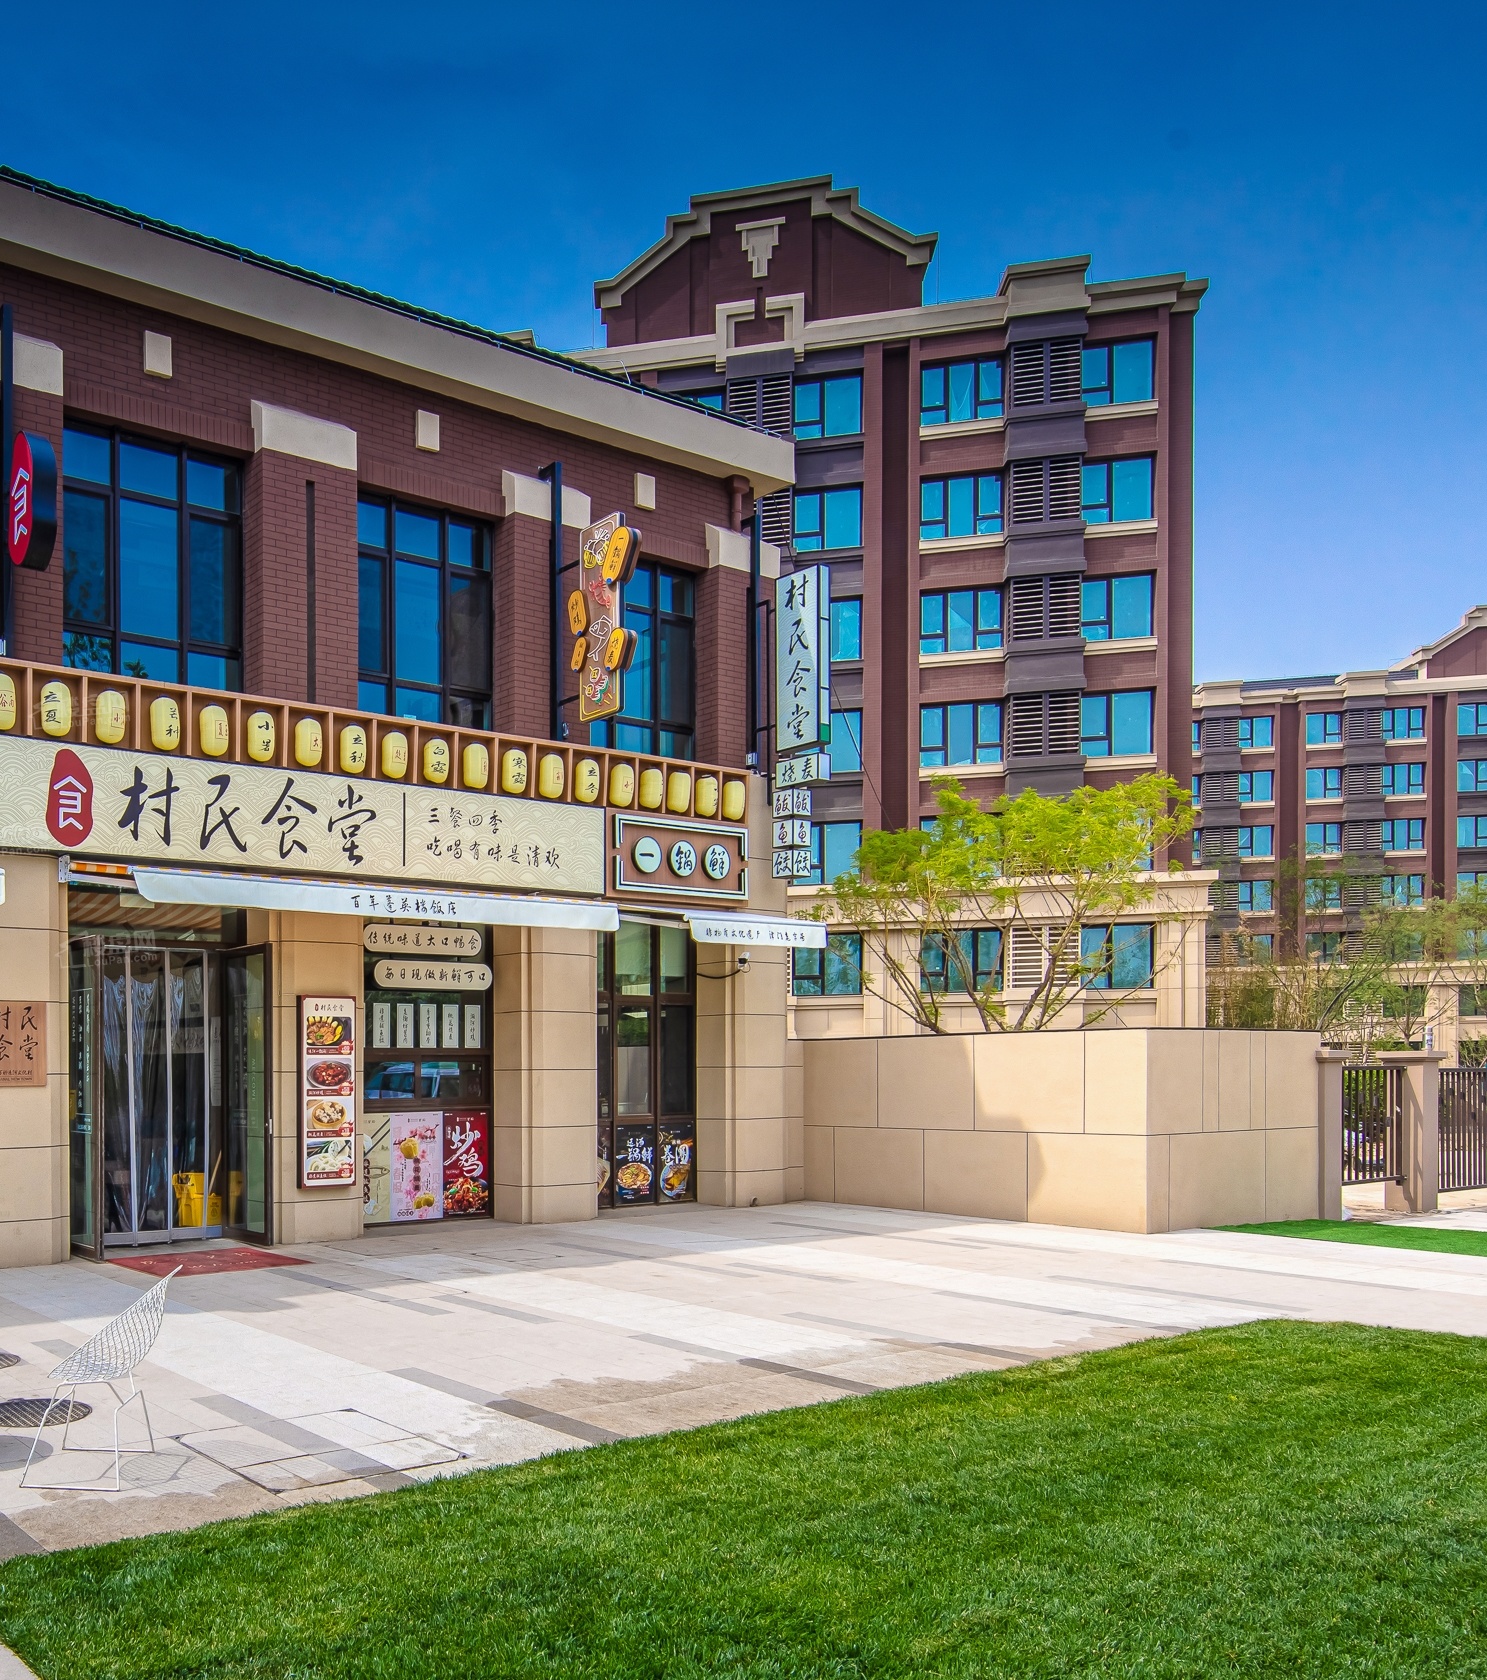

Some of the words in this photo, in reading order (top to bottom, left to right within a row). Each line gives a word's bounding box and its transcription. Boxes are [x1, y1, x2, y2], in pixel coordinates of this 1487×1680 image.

[784, 573, 811, 741] 村民食堂
[43, 691, 62, 724] 立夏
[349, 734, 365, 764] 立秋
[431, 746, 447, 775] 白露
[585, 766, 599, 794] 立冬
[781, 756, 813, 783] 烧麦
[117, 766, 377, 867] 村民食堂
[428, 806, 503, 835] 三餐四季
[426, 836, 561, 870] 吃喝有味是清欢
[443, 1121, 484, 1178] 炒鸡
